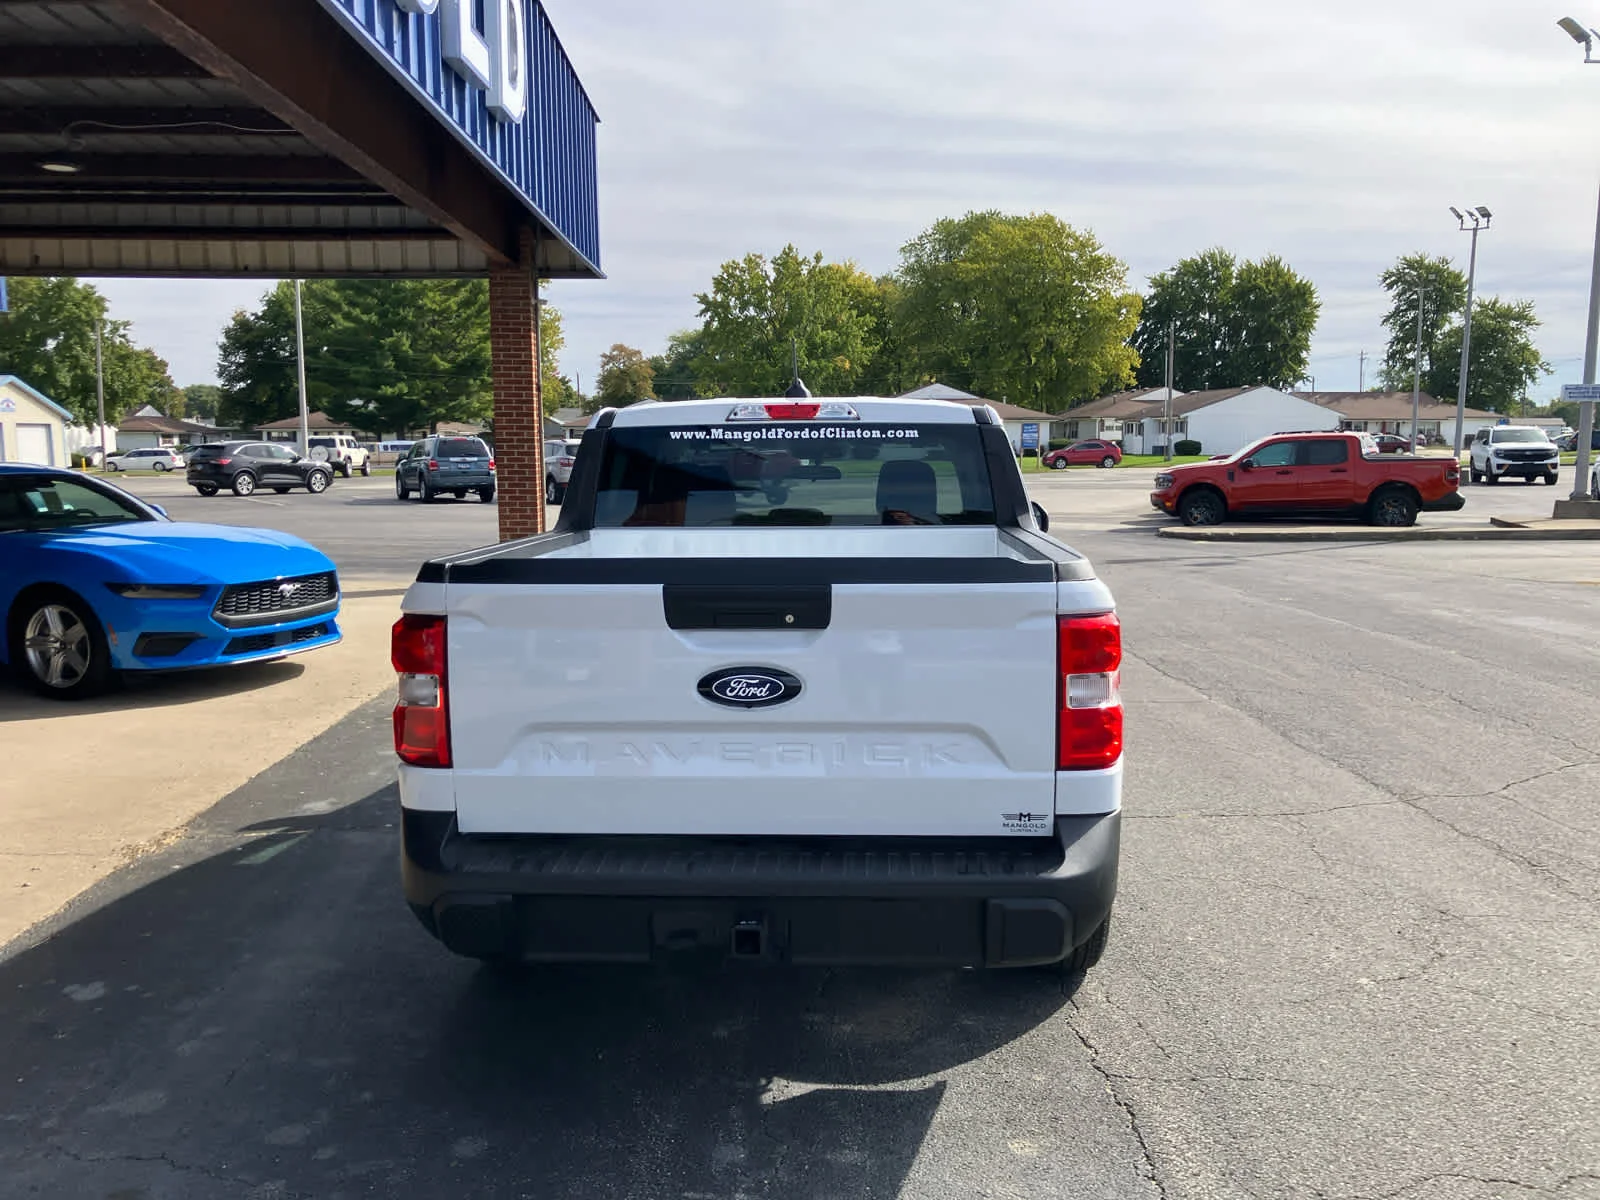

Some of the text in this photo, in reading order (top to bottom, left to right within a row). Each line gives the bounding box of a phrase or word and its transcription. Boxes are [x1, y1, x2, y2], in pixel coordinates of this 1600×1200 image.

[669, 428, 919, 441] www.MangoldFordofClinton.com
[726, 678, 770, 697] Ford
[538, 740, 962, 768] MAVERICK
